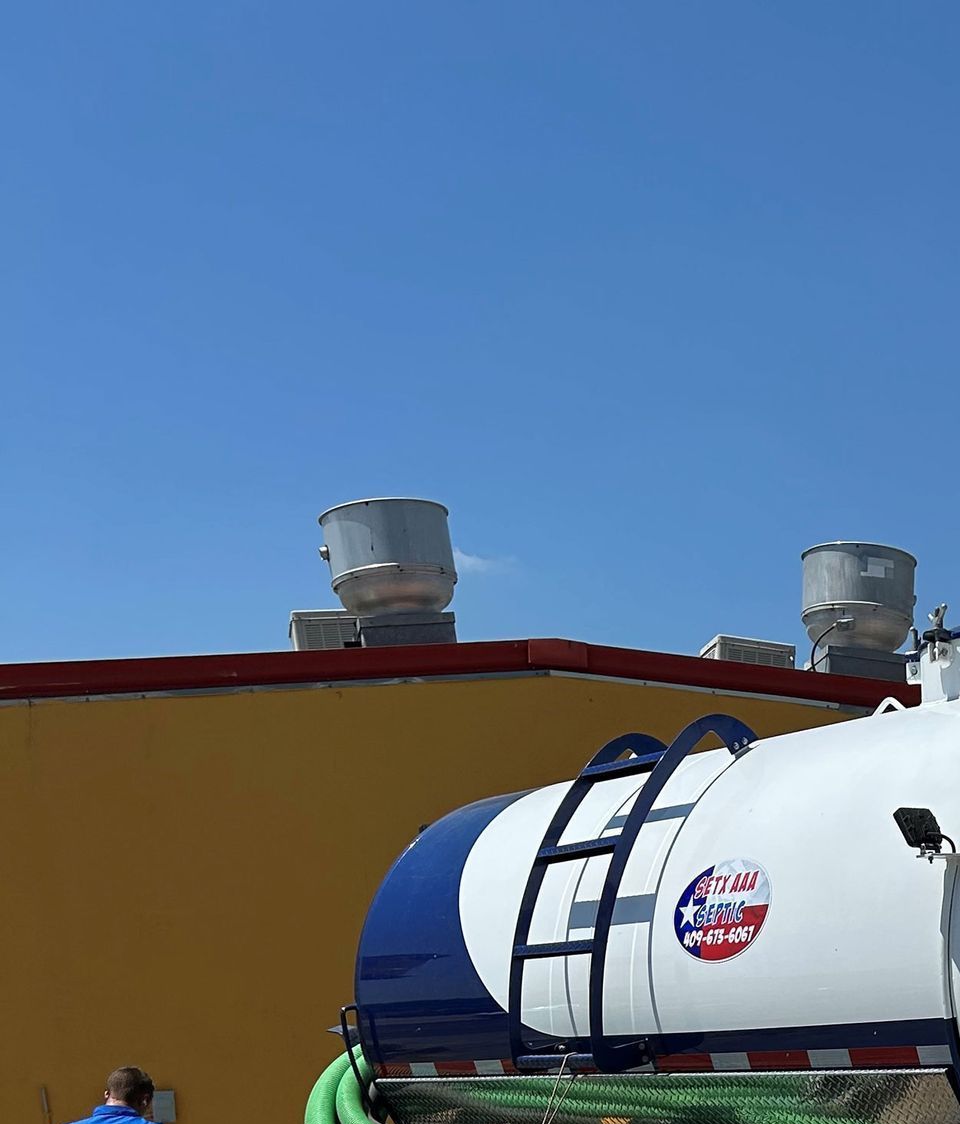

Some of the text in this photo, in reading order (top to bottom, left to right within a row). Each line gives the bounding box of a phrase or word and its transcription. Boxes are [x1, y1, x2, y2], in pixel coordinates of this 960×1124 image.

[694, 871, 759, 899] SETX AAA
[696, 901, 745, 927] SEPTIC
[684, 925, 755, 947] 409-673-6067
